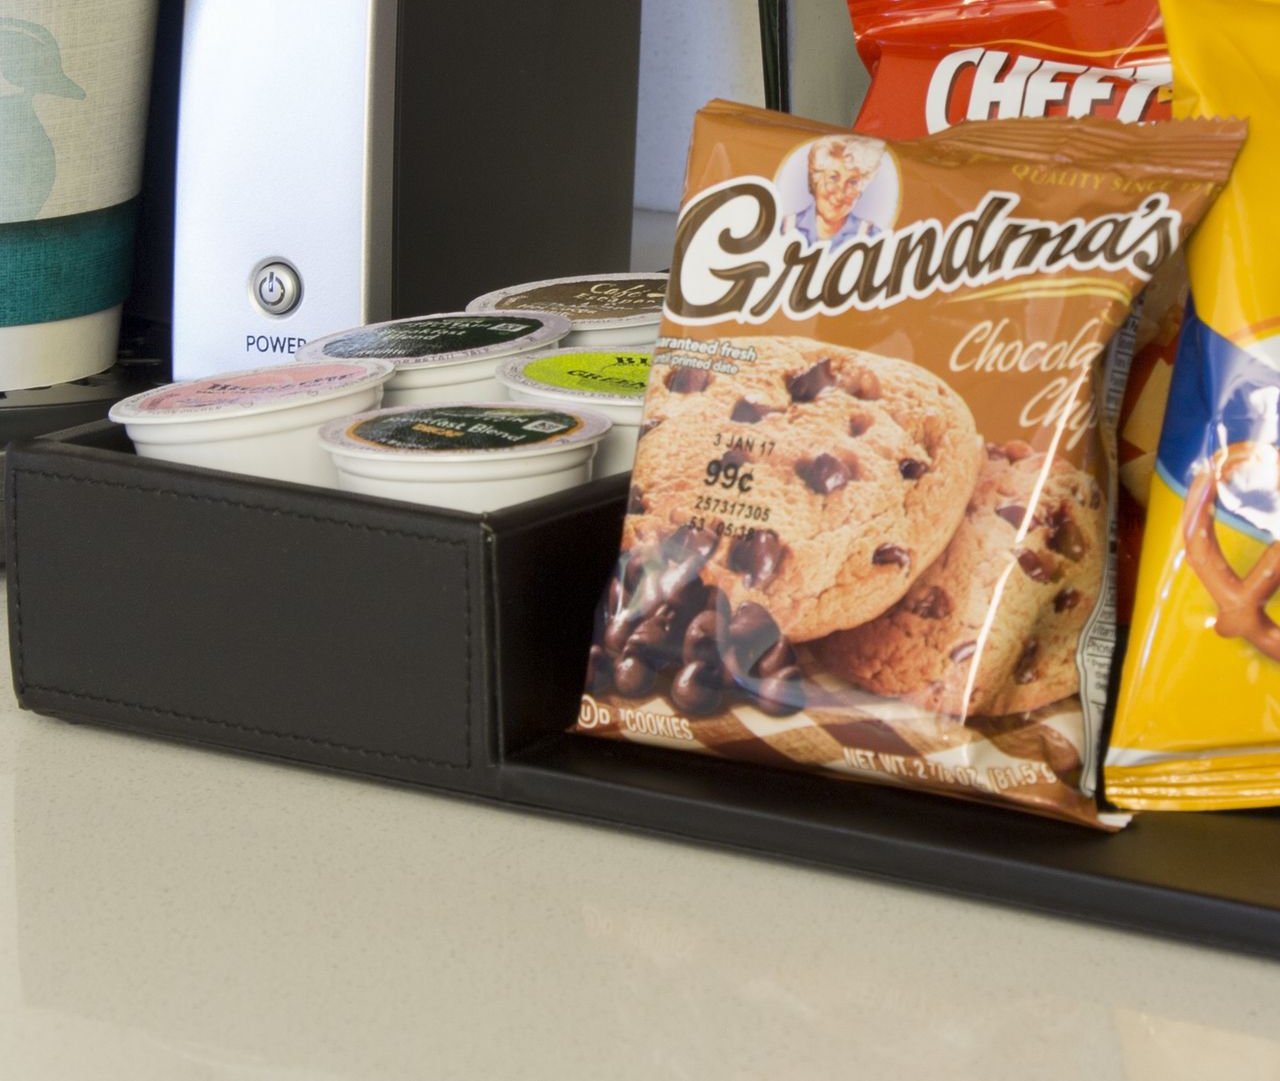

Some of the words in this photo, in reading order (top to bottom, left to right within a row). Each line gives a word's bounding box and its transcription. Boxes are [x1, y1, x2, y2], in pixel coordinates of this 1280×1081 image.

[925, 47, 1174, 135] CHEET
[664, 179, 1177, 321] Grandma's
[720, 341, 757, 361] fresh
[949, 317, 1104, 373] Chocola
[672, 355, 712, 370] printed
[712, 360, 740, 374] date
[712, 433, 721, 447] 3
[726, 436, 755, 453] JAN
[759, 440, 776, 456] 17
[624, 709, 694, 741] COOKIES
[843, 746, 876, 770] NET
[878, 751, 914, 778] WT.
